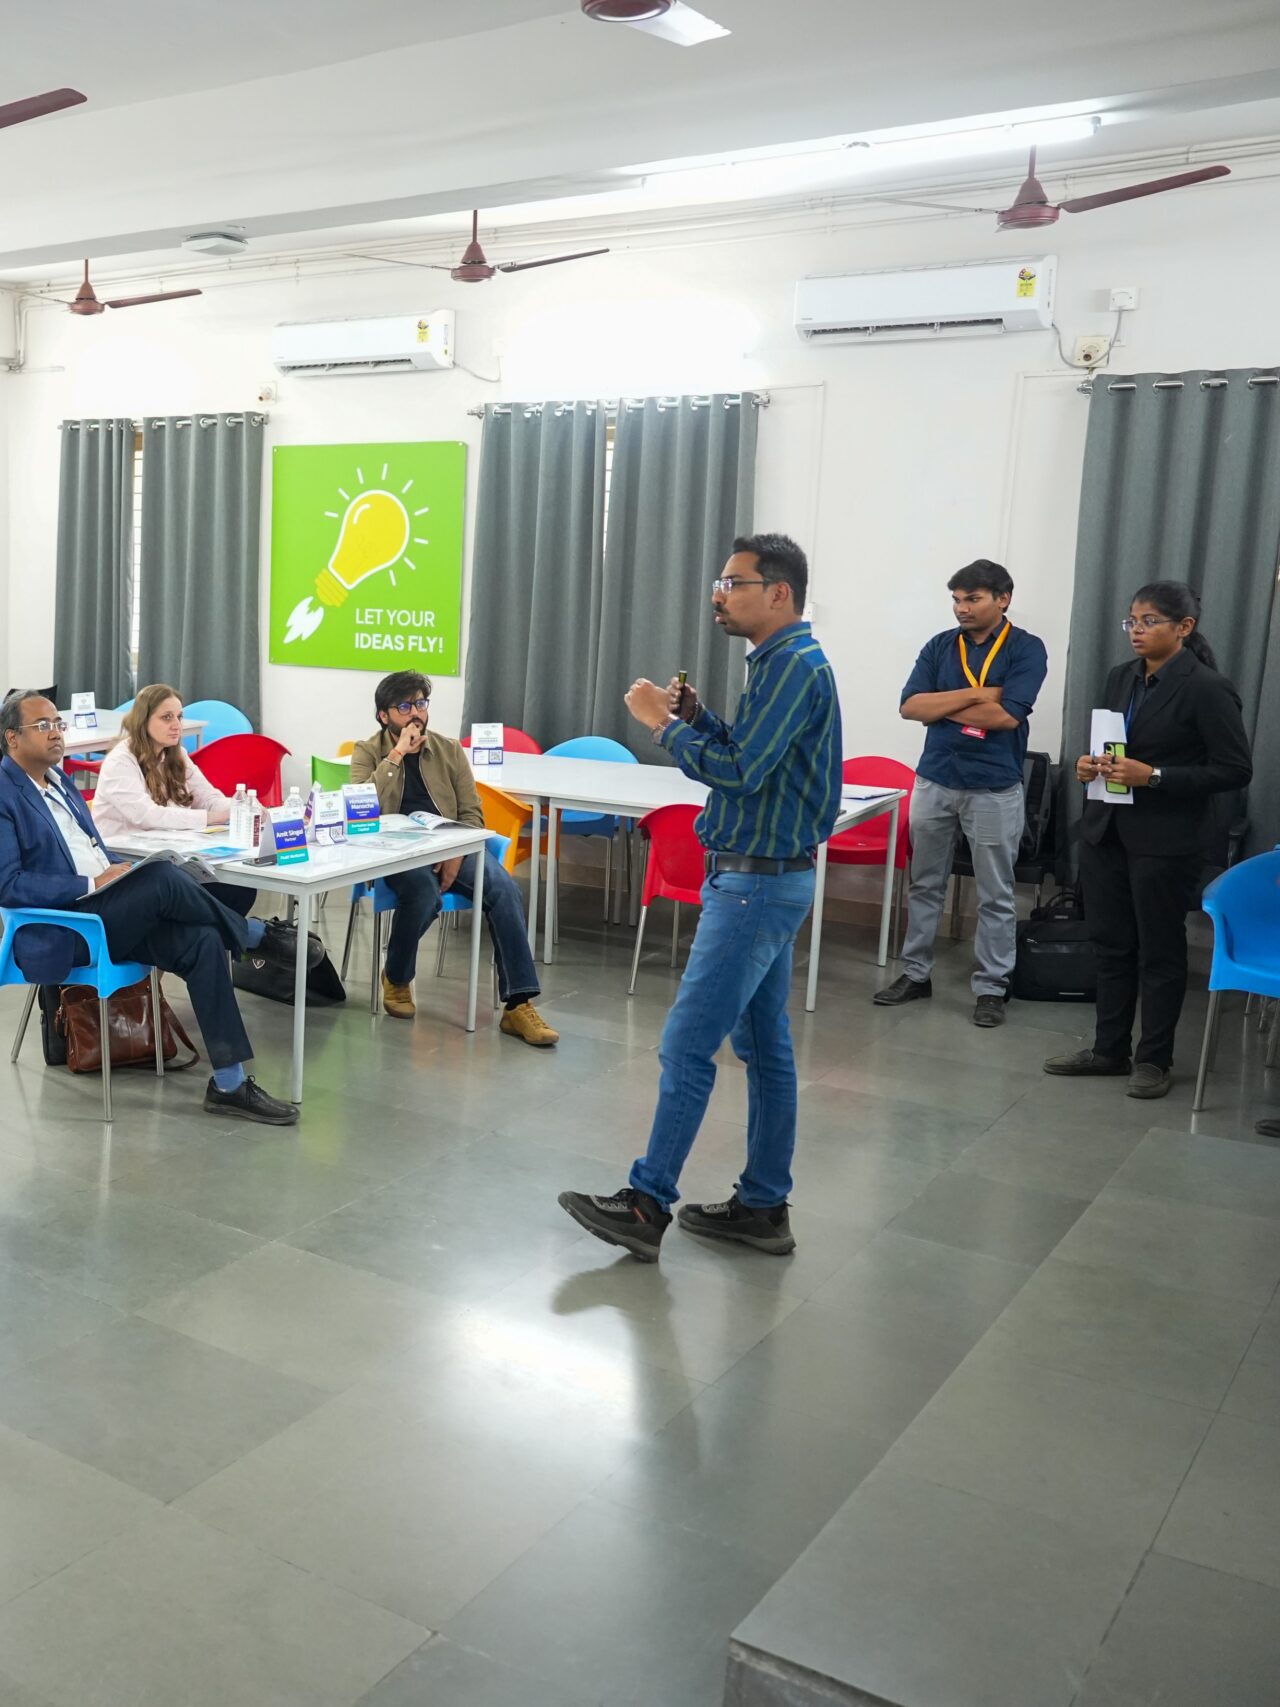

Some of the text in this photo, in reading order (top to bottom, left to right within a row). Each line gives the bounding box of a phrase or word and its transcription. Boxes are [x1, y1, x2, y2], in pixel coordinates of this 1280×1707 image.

[355, 607, 436, 628] LET YOUR
[355, 632, 405, 651] IDEAS
